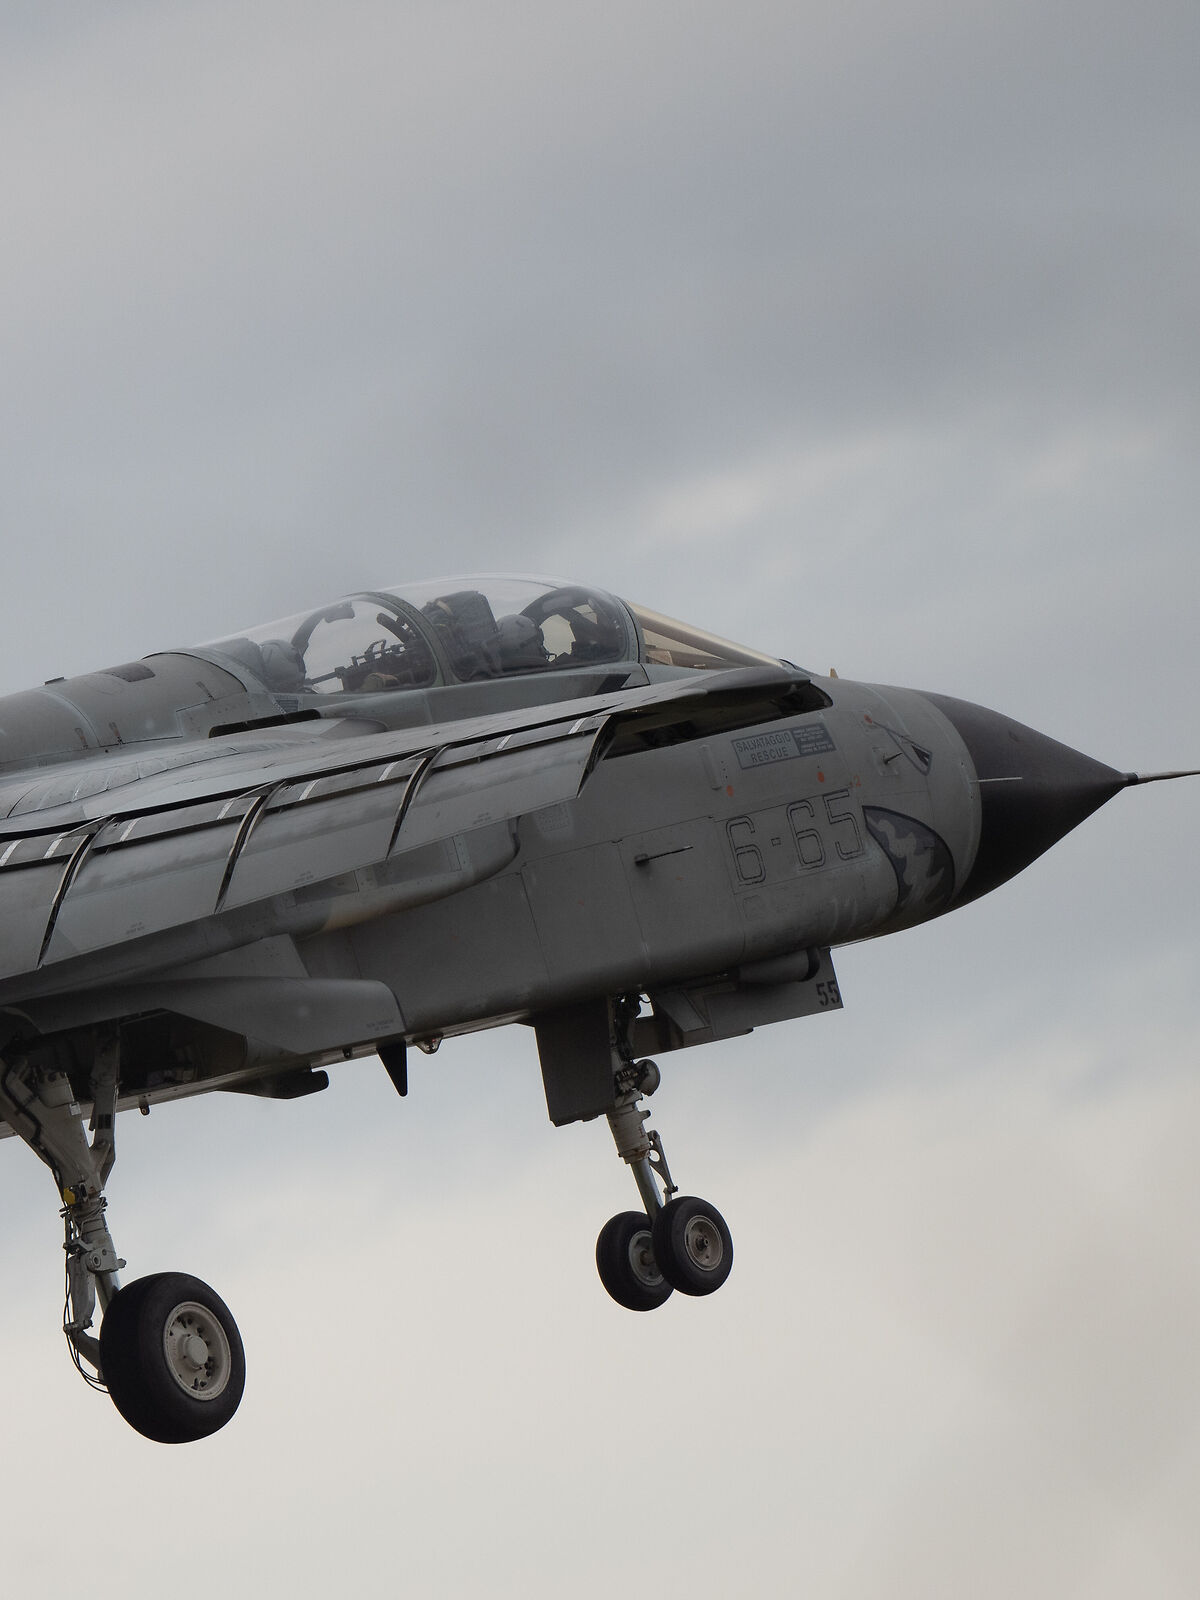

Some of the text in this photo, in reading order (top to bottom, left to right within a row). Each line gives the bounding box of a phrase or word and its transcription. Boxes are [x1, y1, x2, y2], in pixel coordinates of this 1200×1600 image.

[736, 732, 791, 752] SALVATAGGIO
[751, 746, 789, 763] RESCUE
[726, 788, 866, 887] 6-65
[816, 980, 840, 1006] 55
